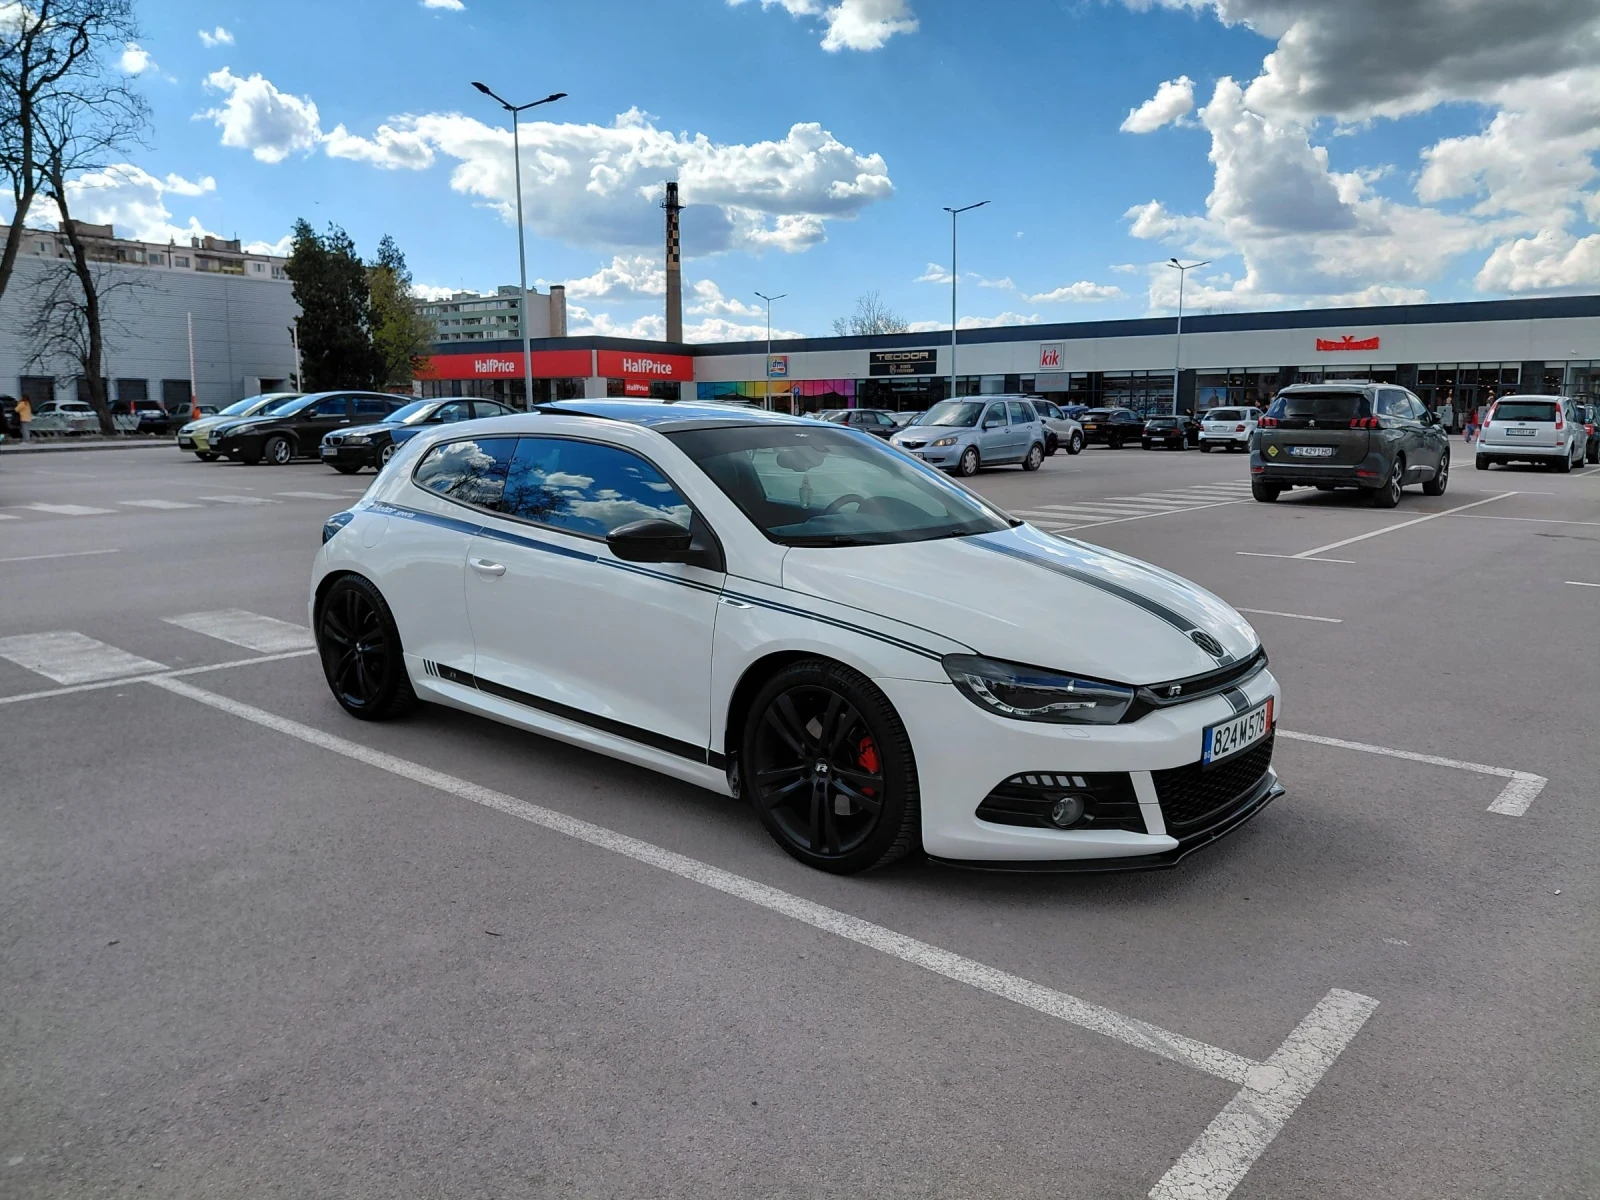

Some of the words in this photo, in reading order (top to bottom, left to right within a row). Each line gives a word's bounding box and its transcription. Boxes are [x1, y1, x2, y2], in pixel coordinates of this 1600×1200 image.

[876, 352, 929, 361] TEODOR
[475, 360, 515, 373] HalfPrice
[623, 358, 672, 375] HalfPrice
[772, 358, 784, 368] dm
[626, 383, 649, 392] HalfPrice
[1169, 684, 1182, 697] R
[815, 763, 829, 773] R
